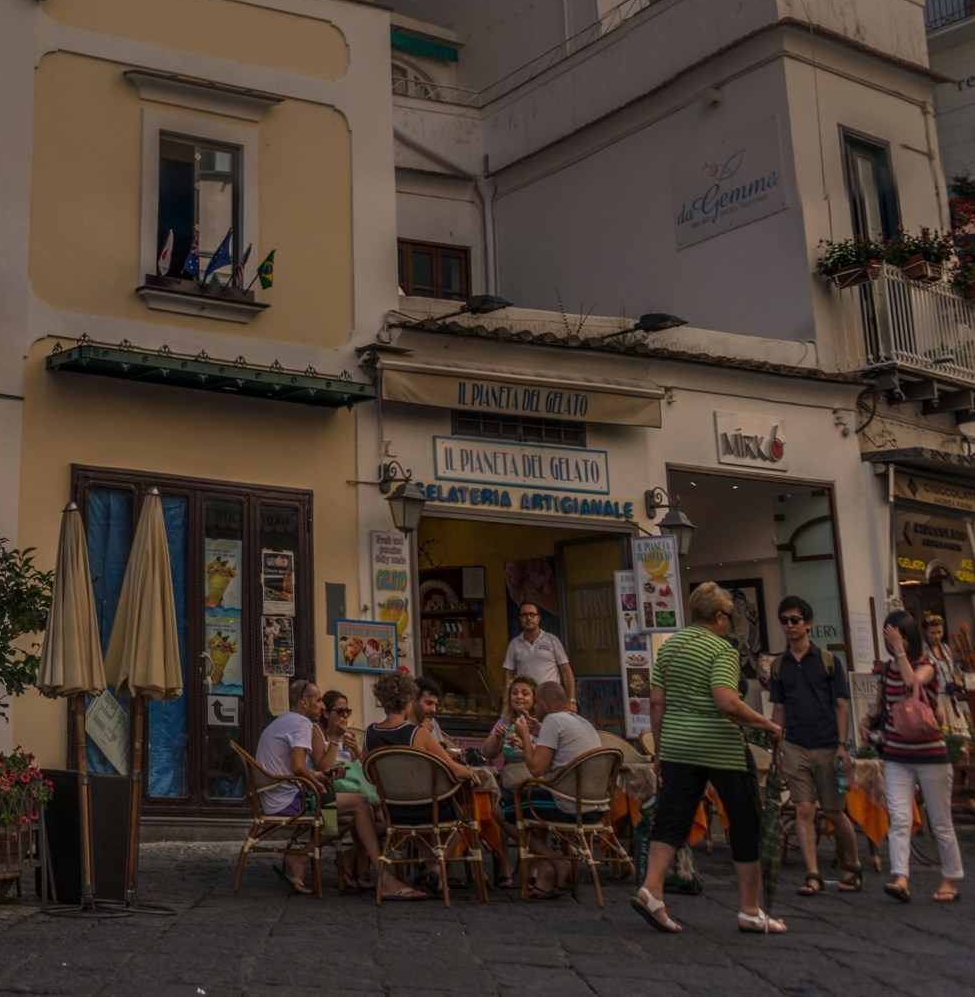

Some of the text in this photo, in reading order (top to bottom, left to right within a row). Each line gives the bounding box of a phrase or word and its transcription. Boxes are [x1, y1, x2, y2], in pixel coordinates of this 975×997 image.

[677, 171, 778, 225] da Gemma
[458, 382, 588, 417] IL PIANETA DEL GELATO
[444, 447, 600, 484] IL PIANETA DEL GELATO
[414, 481, 634, 519] GELATERIA ARTIGIANALE
[810, 624, 838, 638] LERY
